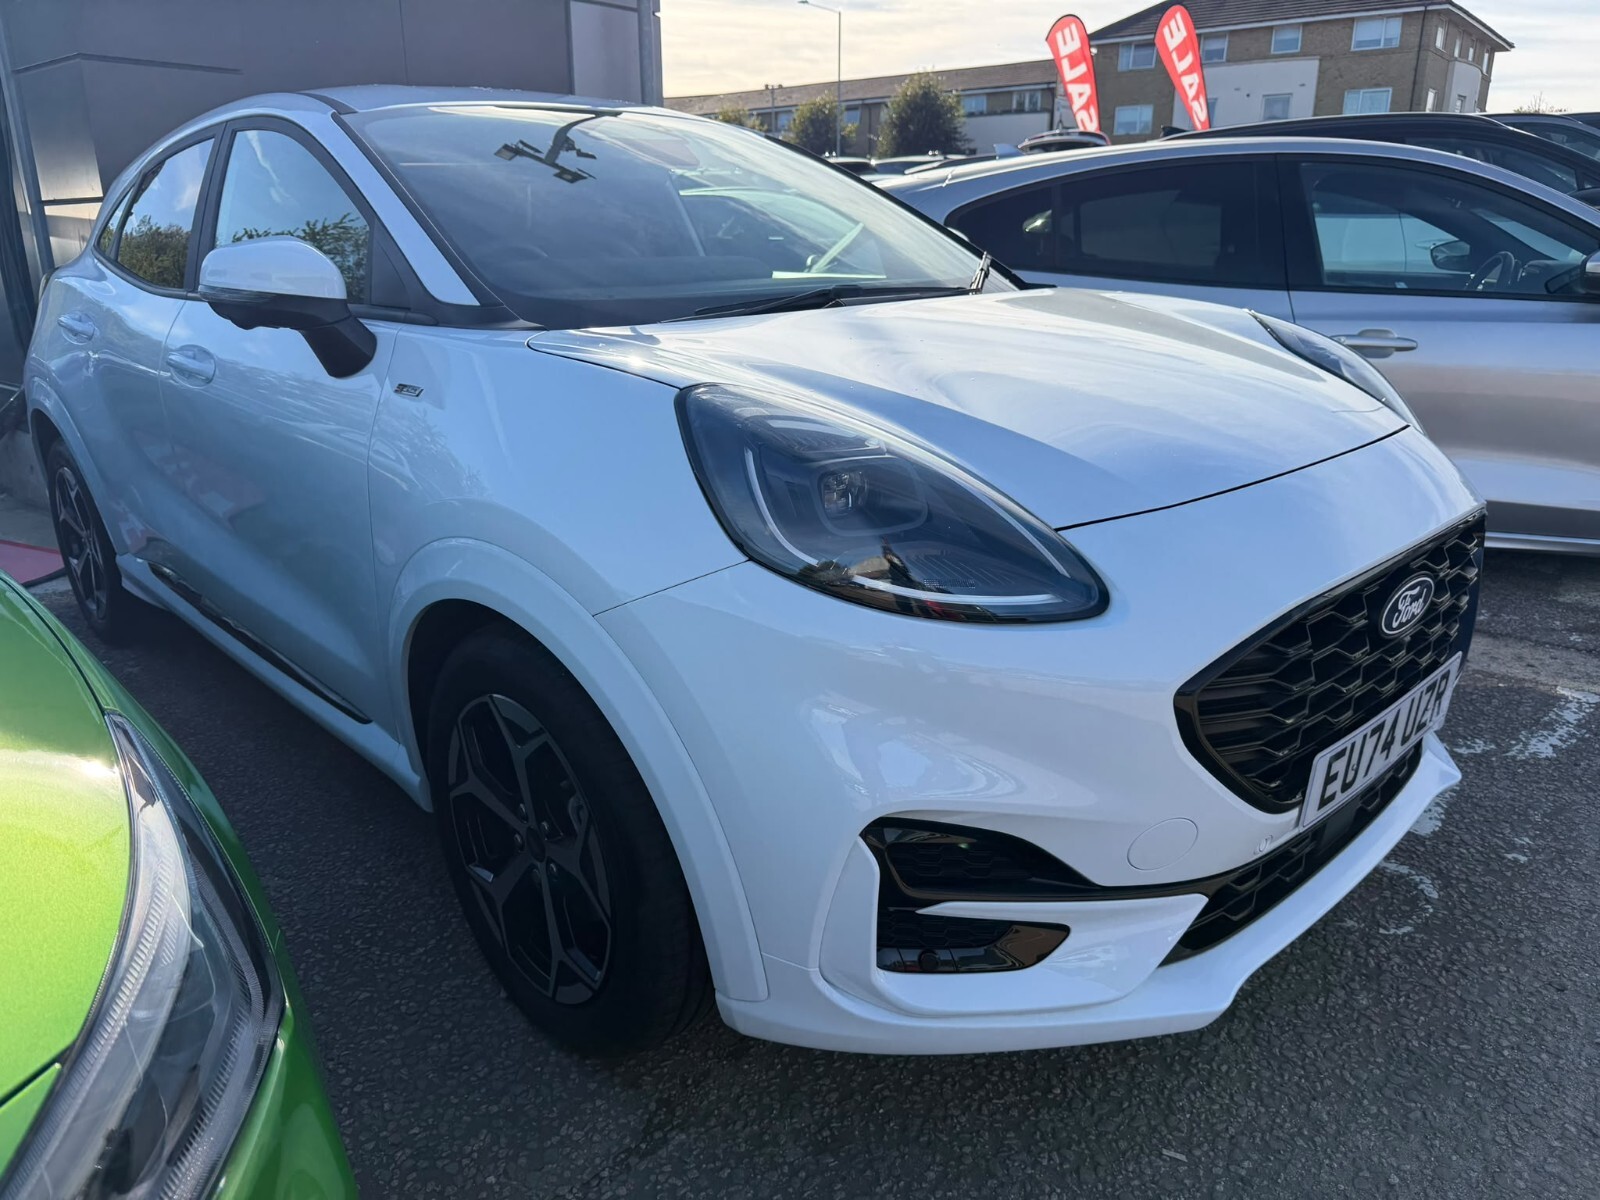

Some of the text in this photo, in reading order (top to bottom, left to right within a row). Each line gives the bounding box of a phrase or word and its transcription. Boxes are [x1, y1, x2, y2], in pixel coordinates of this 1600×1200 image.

[1391, 585, 1427, 629] Ford
[1317, 669, 1451, 812] EU74 UZR
